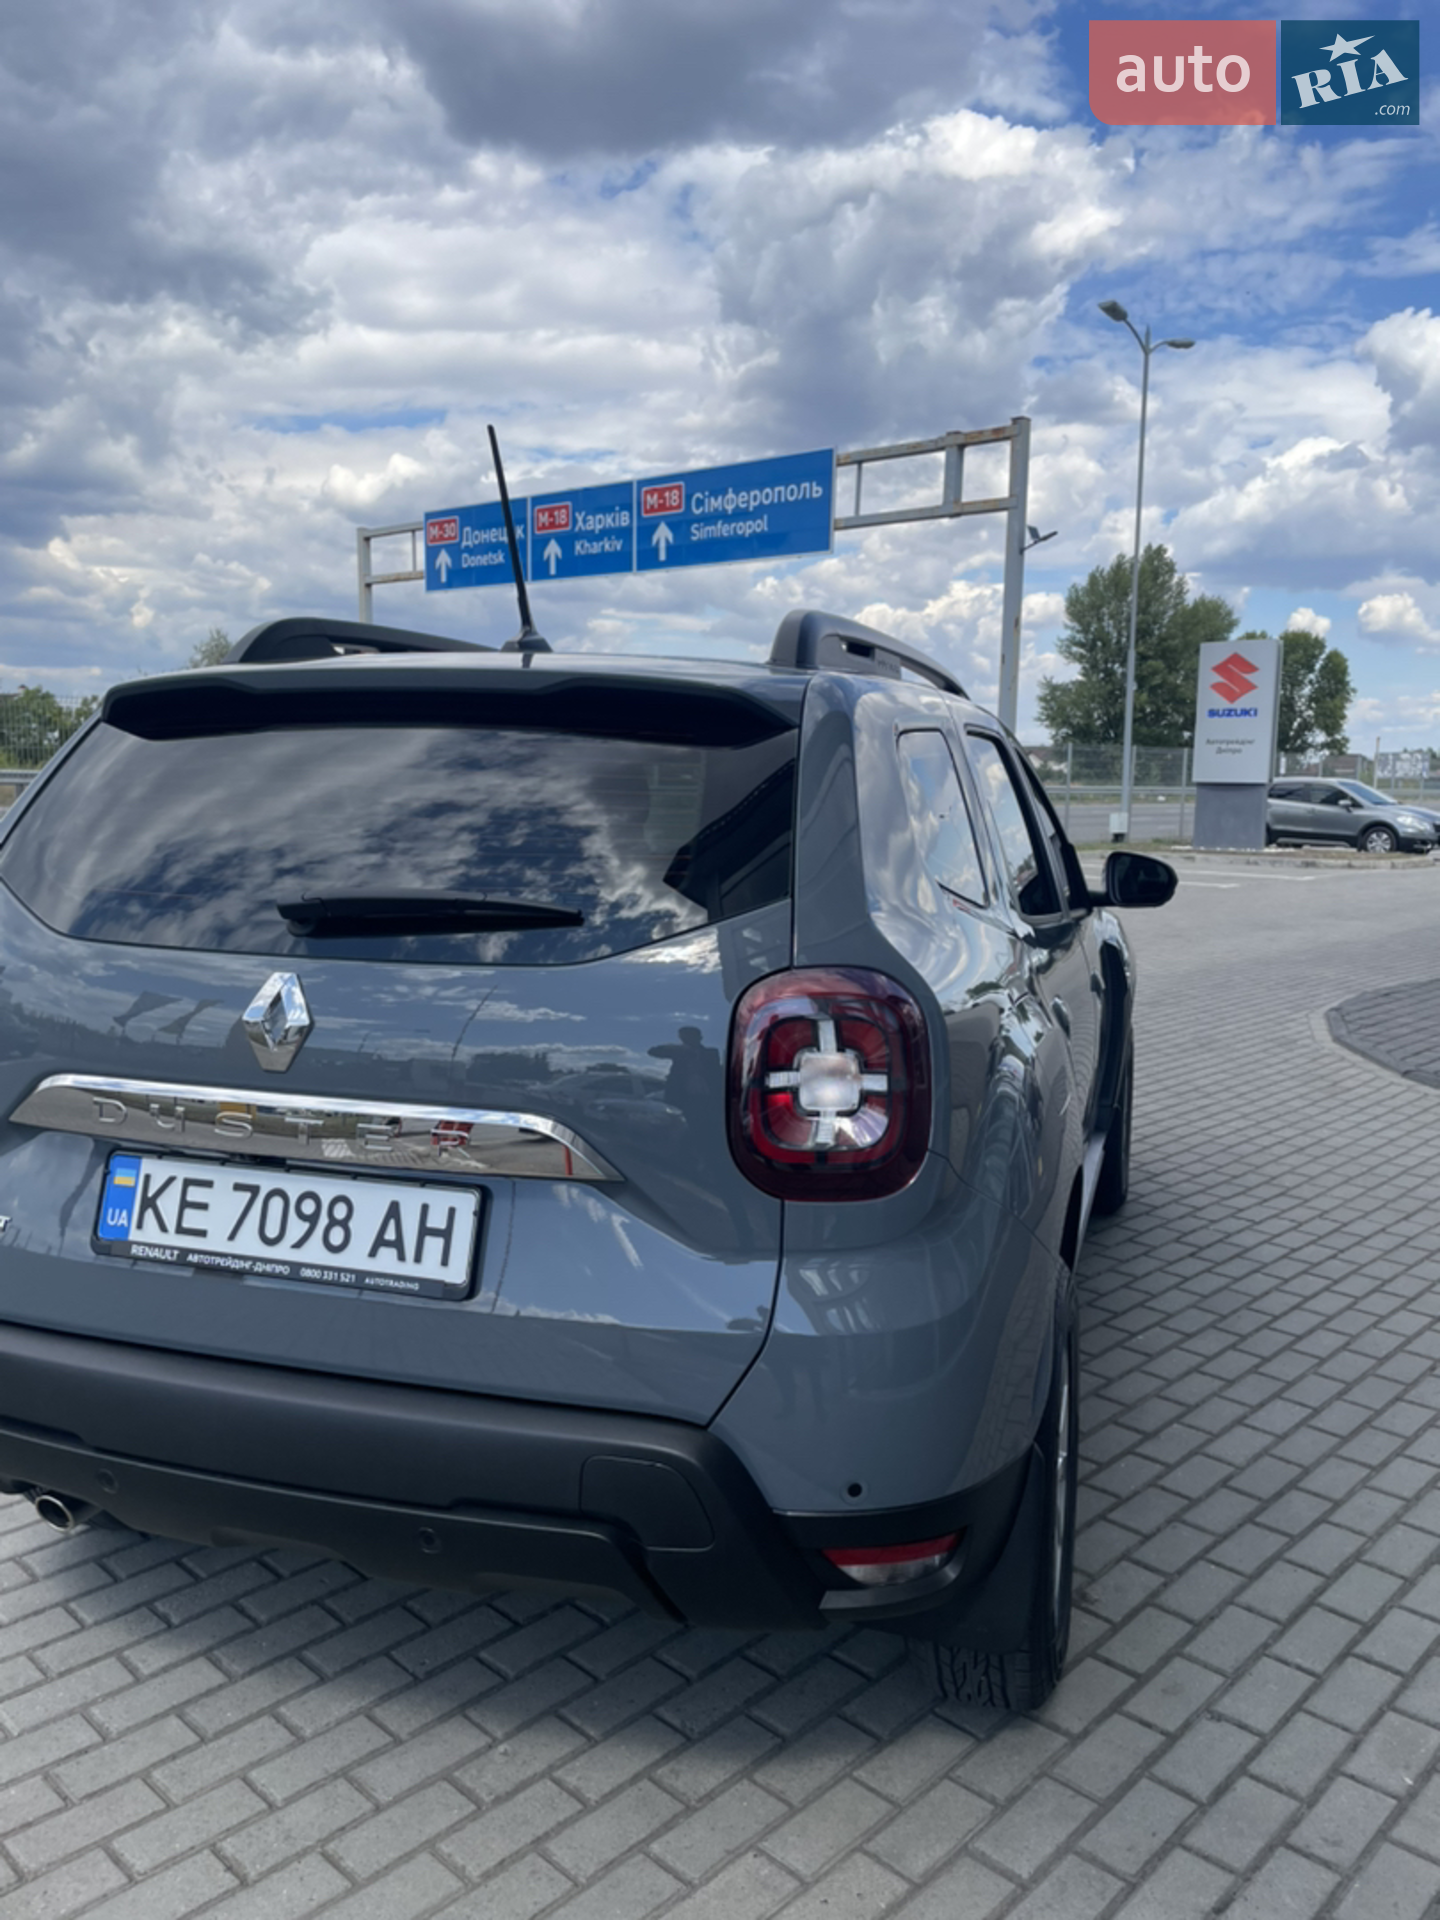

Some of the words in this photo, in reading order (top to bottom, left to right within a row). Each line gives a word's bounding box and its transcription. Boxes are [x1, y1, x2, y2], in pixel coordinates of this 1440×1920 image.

[690, 480, 823, 515] Сімферополь
[574, 505, 631, 534] Харків
[690, 514, 769, 542] Simferopol
[461, 523, 525, 550] Донецк
[574, 535, 624, 556] Kharkiv
[461, 549, 506, 569] Donetsk
[1207, 707, 1258, 718] SUZUKI
[93, 1096, 471, 1159] DUSTER
[106, 1207, 129, 1228] UA
[135, 1172, 215, 1239] KE
[226, 1182, 354, 1255] 7098
[367, 1199, 457, 1268] AH
[130, 1243, 180, 1262] RENAULT
[300, 1266, 322, 1280] 0800
